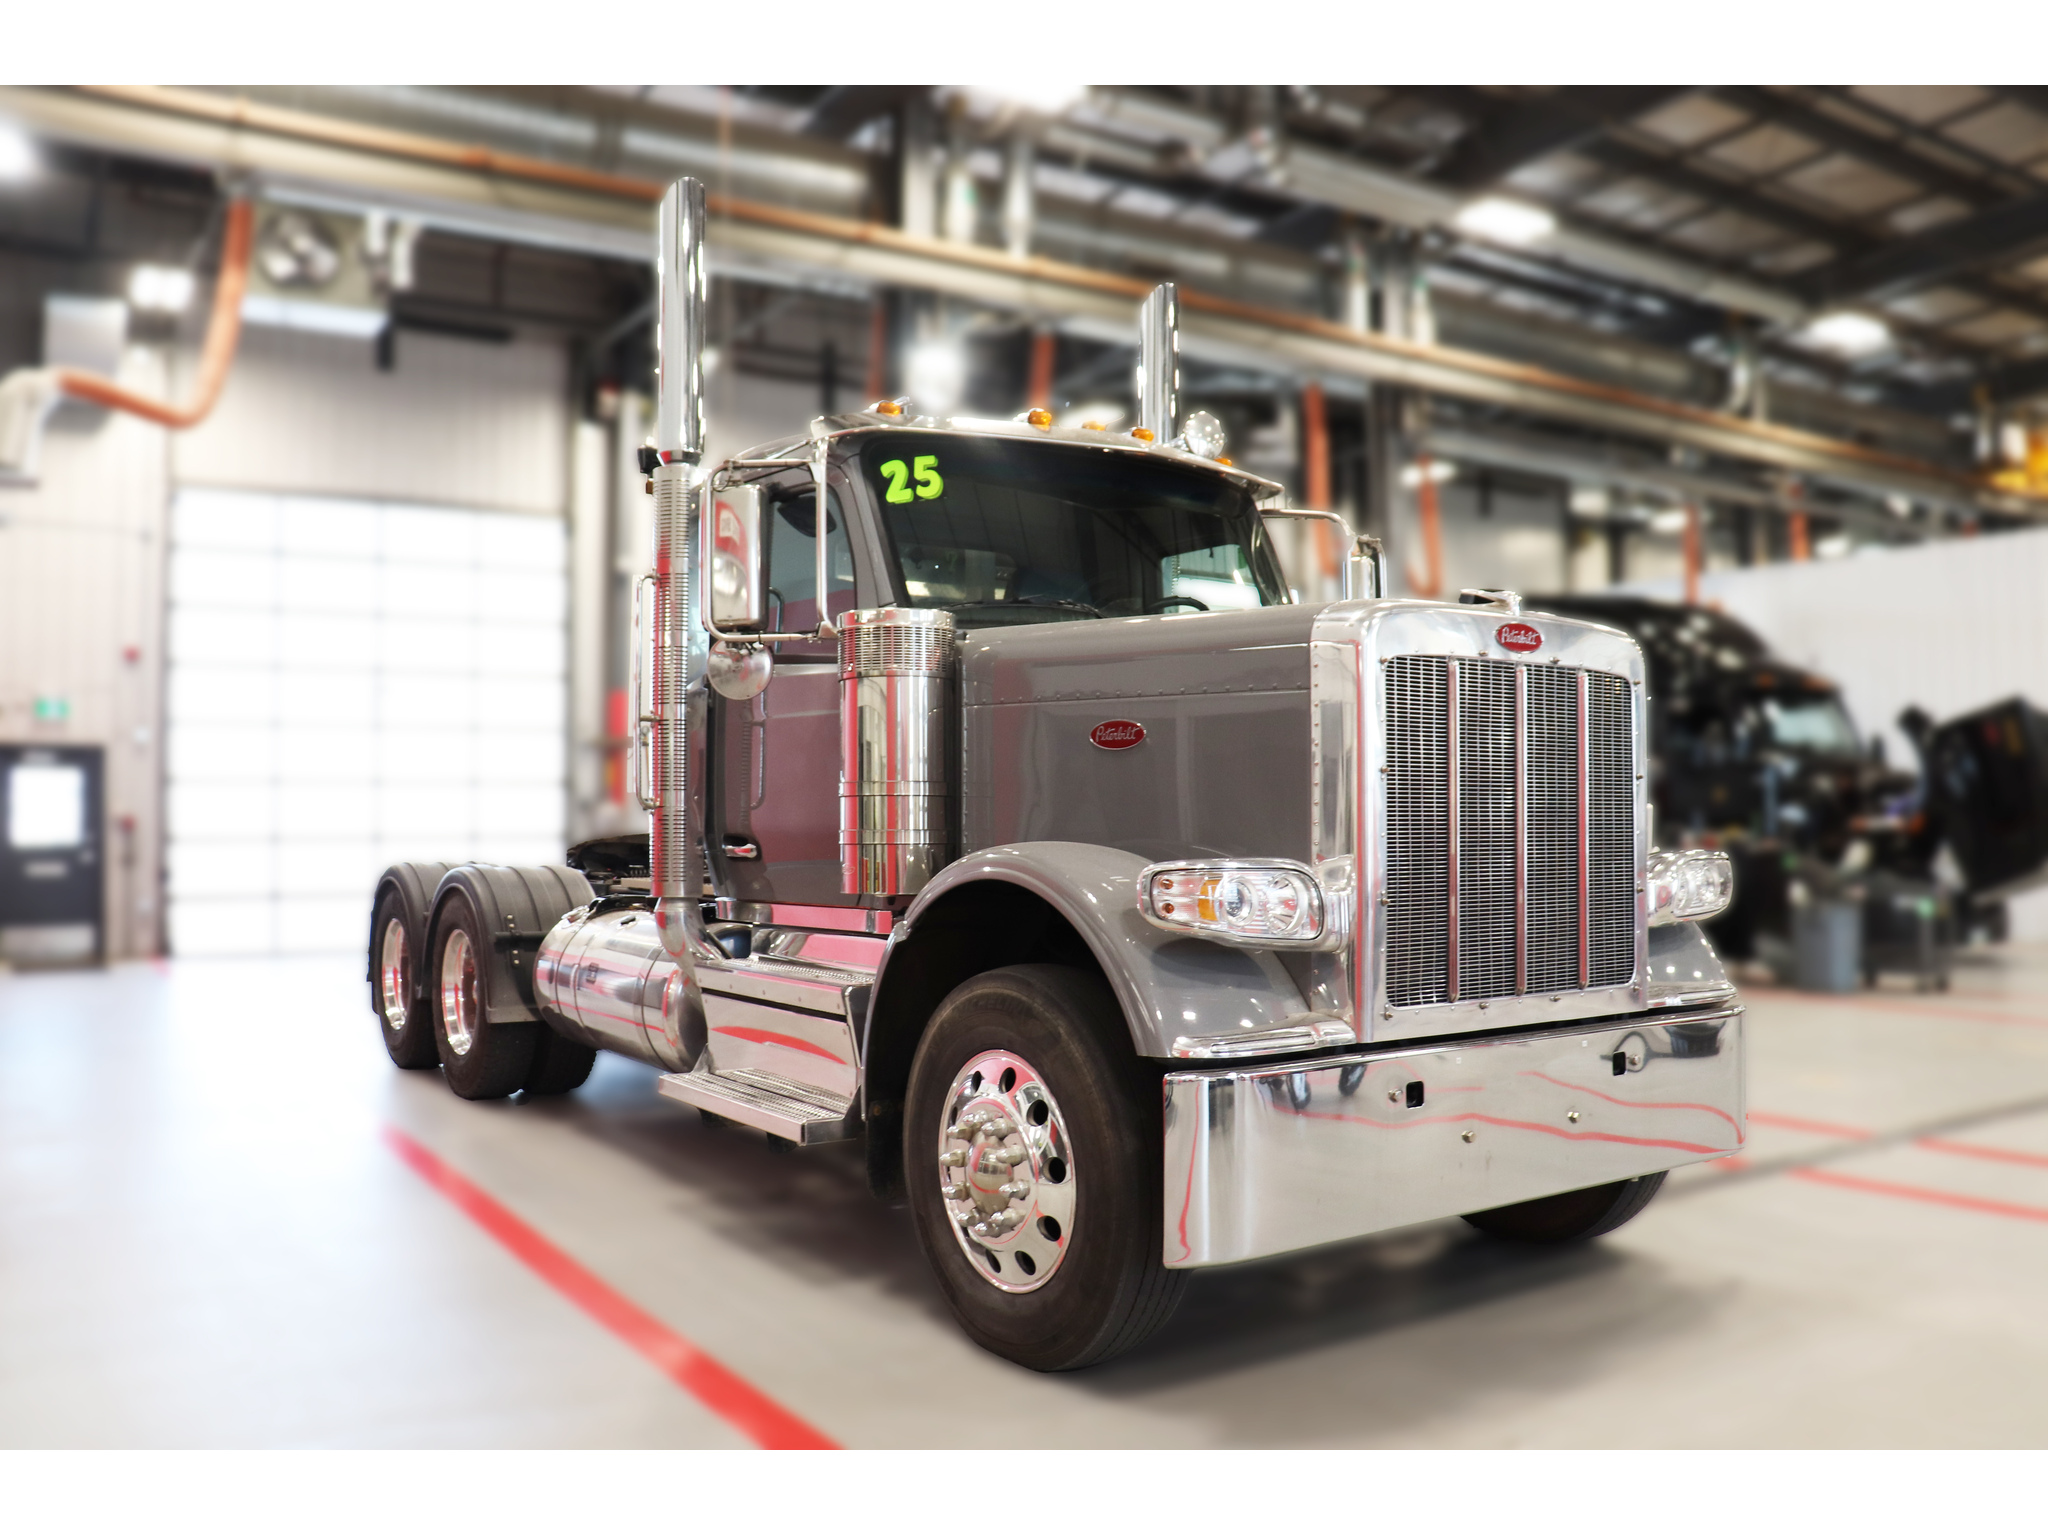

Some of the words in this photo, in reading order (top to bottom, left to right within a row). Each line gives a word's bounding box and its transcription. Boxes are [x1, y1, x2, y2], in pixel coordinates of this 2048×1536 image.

[880, 455, 944, 504] 25
[1501, 626, 1540, 645] Peterbilt
[1095, 725, 1140, 742] Peterbilt
